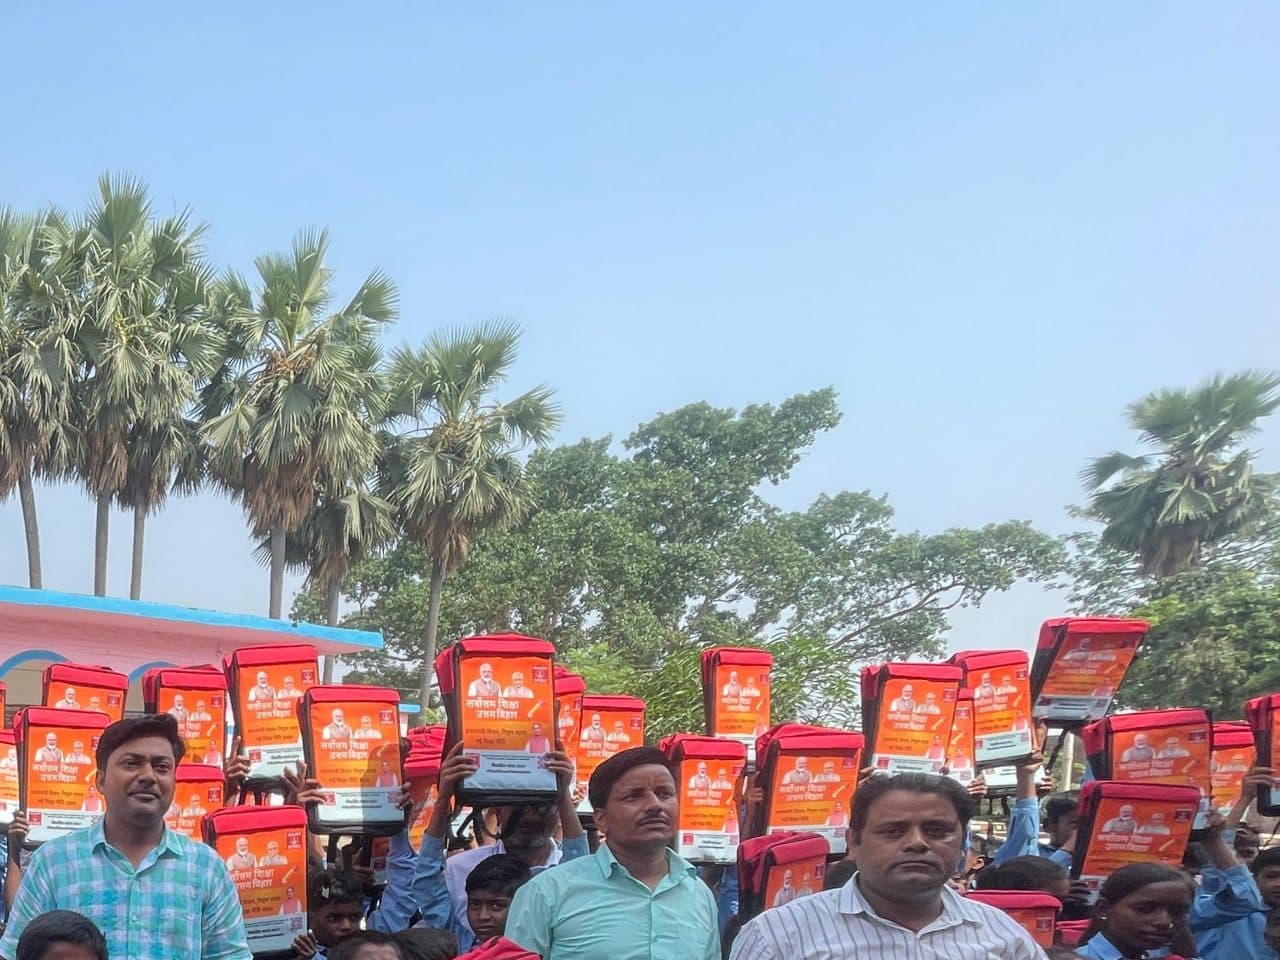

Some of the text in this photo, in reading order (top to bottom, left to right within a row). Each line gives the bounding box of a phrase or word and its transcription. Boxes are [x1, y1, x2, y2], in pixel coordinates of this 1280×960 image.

[465, 696, 520, 709] सर्वोत्तम शिक्षा
[475, 708, 518, 720] उत्तम बिहार
